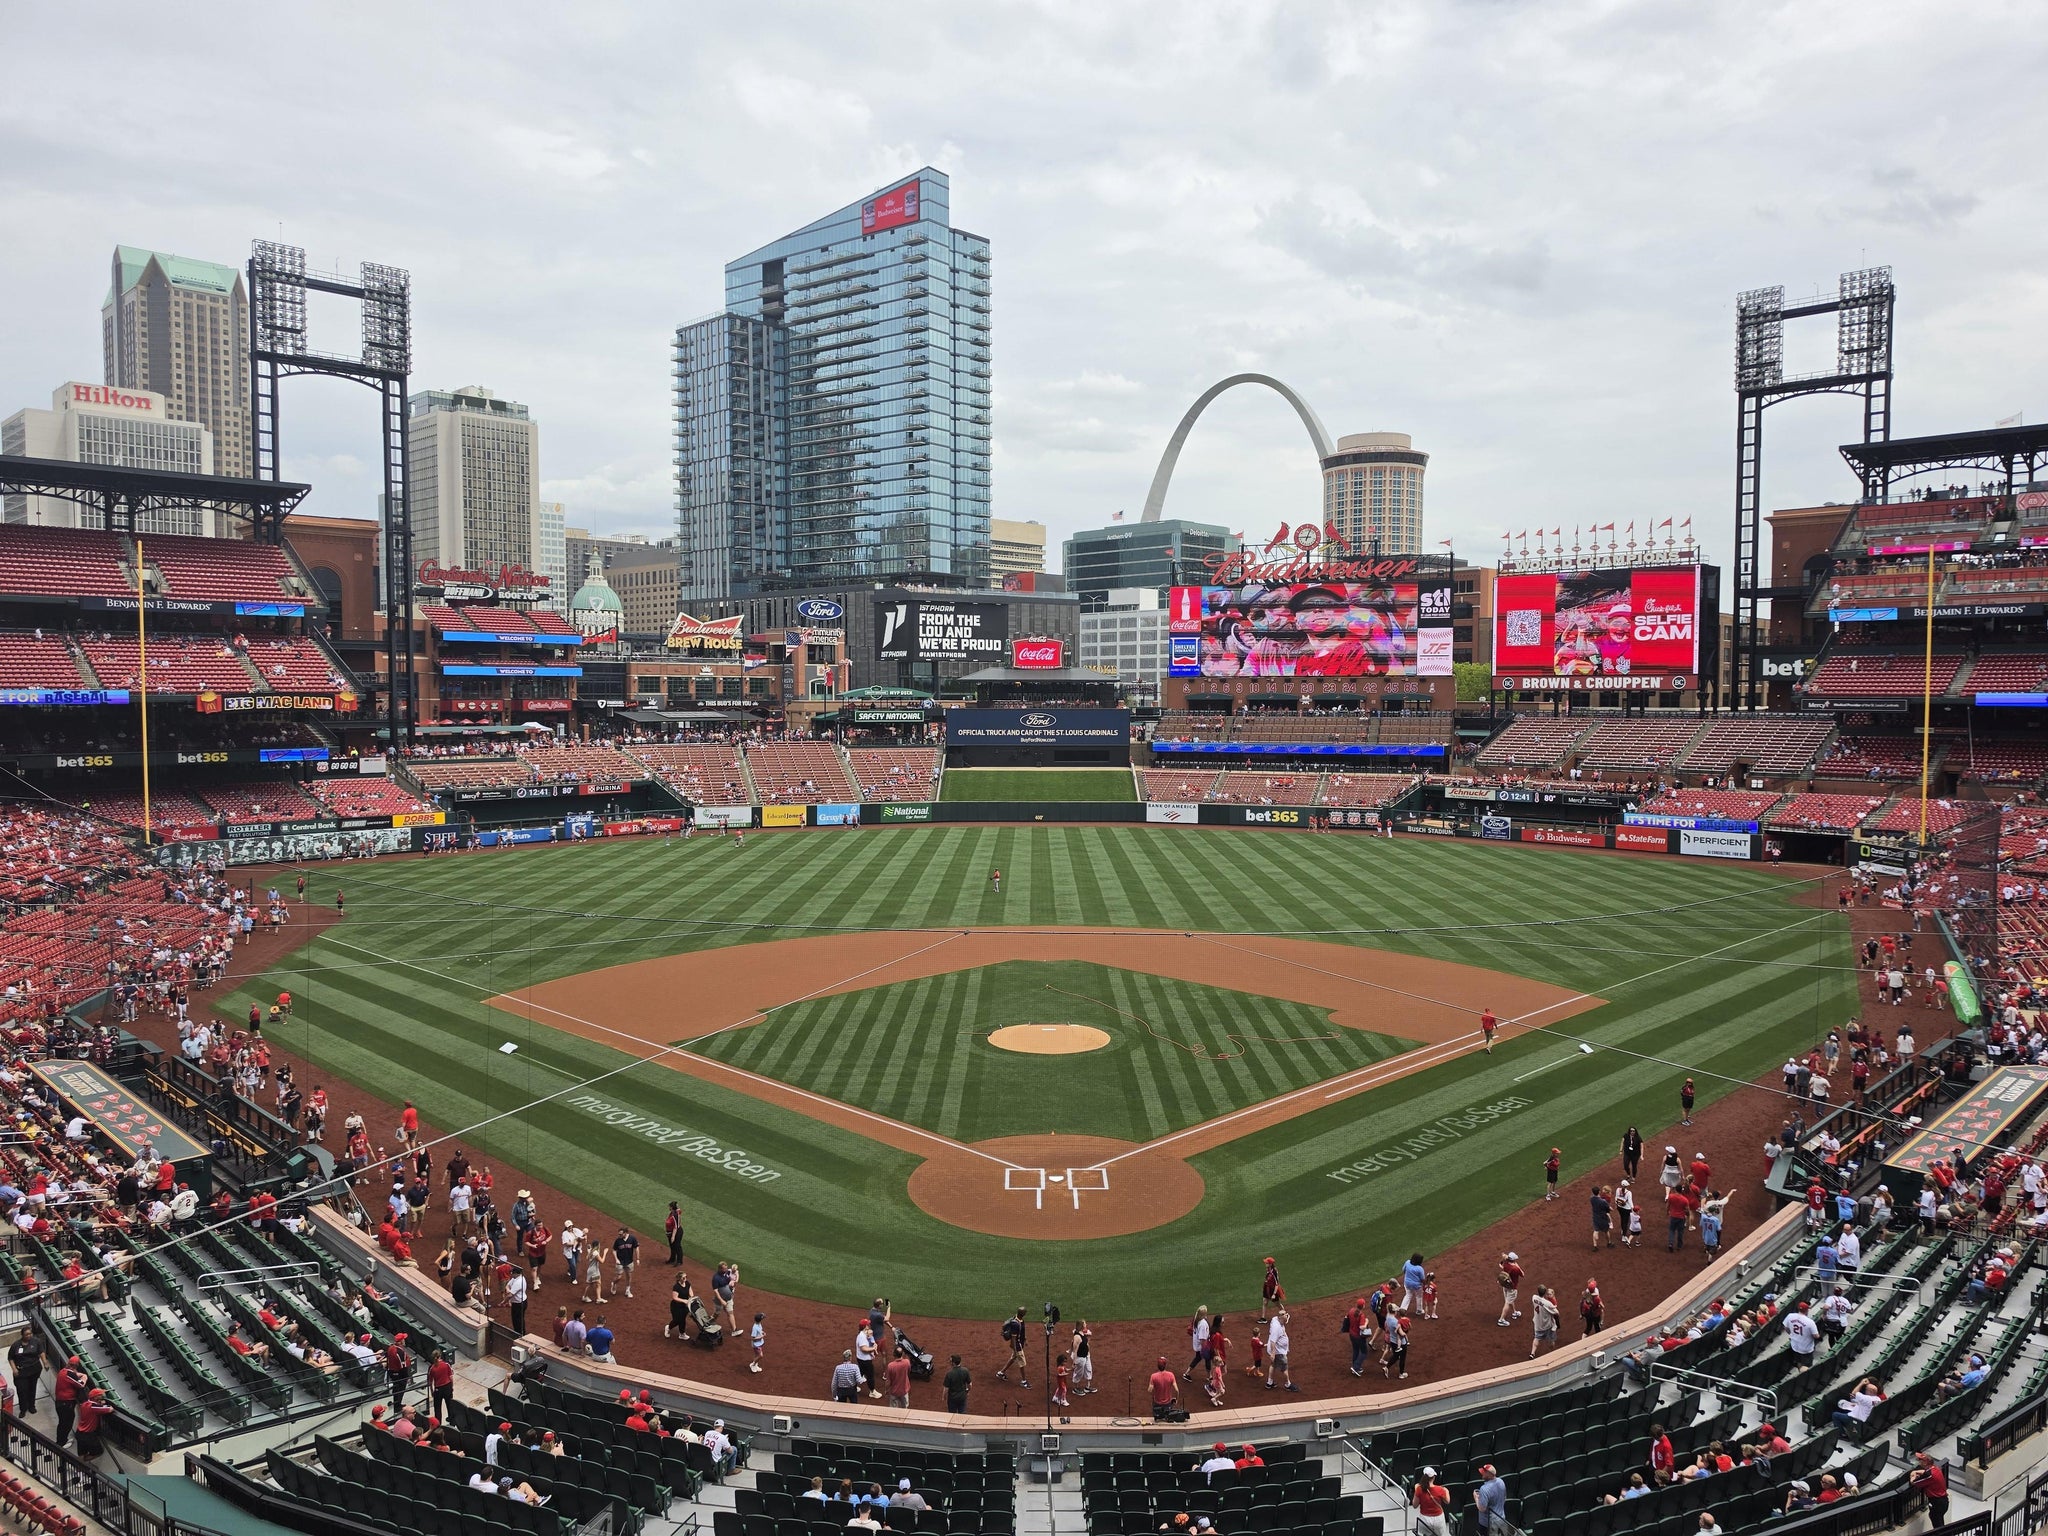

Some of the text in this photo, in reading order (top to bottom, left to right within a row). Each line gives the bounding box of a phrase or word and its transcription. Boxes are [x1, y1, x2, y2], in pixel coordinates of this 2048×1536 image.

[878, 206, 904, 218] Budweiser
[74, 384, 152, 410] Hilton
[1203, 550, 1418, 585] Budweiser
[1514, 551, 1680, 572] WORLD CHAMPIONS
[420, 560, 550, 588] Cardinals Nation
[444, 586, 484, 597] HOFFMANN
[498, 590, 540, 600] ROOFTOP
[1421, 588, 1450, 606] stl
[156, 601, 164, 609] F.
[808, 600, 835, 616] Ford
[1964, 607, 1972, 615] F.
[919, 613, 980, 626] FROM THE
[1171, 620, 1200, 630] Coca-Cola
[1634, 614, 1692, 626] SELFIE
[667, 619, 743, 638] Budweiser
[919, 626, 972, 638] LOU AND
[1634, 625, 1692, 641] CAM
[667, 637, 742, 650] BREW HOUSE
[918, 638, 1002, 651] WE'RE PROUD
[1019, 647, 1056, 660] Coca-Cola
[1200, 683, 1204, 693] 1
[1211, 683, 1217, 693] 2
[1223, 683, 1230, 693] 6
[1236, 683, 1243, 693] 9
[1266, 683, 1277, 693] 14
[1284, 683, 1294, 693] 17
[1301, 683, 1315, 693] 20
[1323, 683, 1337, 693] 23
[1342, 683, 1357, 693] 24
[1363, 683, 1377, 693] 42
[1384, 683, 1399, 693] 45
[1523, 678, 1570, 688] BROWN
[1573, 680, 1582, 688] &
[1586, 677, 1660, 688] CROUPPEN
[9, 693, 39, 702] FOR
[45, 691, 112, 703] BASEBALL
[224, 696, 333, 710] BIG MAC LAND
[1026, 714, 1049, 725] Ford
[56, 756, 113, 767] bet365
[178, 752, 228, 763] bet365
[1448, 789, 1490, 797] Schnucks
[894, 807, 928, 816] National
[1246, 810, 1298, 822] bet365
[1488, 818, 1505, 827] Ford
[1625, 816, 1644, 825] IT'S
[1647, 817, 1671, 827] TIME
[1674, 818, 1696, 828] FOR
[1408, 826, 1453, 836] BUSCH STADIUM
[424, 832, 457, 844] STIFEL
[1546, 833, 1592, 844] Budweiser
[1693, 837, 1748, 846] PERFICIENT
[567, 1095, 782, 1183] mercy.net/BeSeen
[1326, 1096, 1534, 1183] mercy.net/BeSeen
[1793, 1324, 1803, 1336] 21
